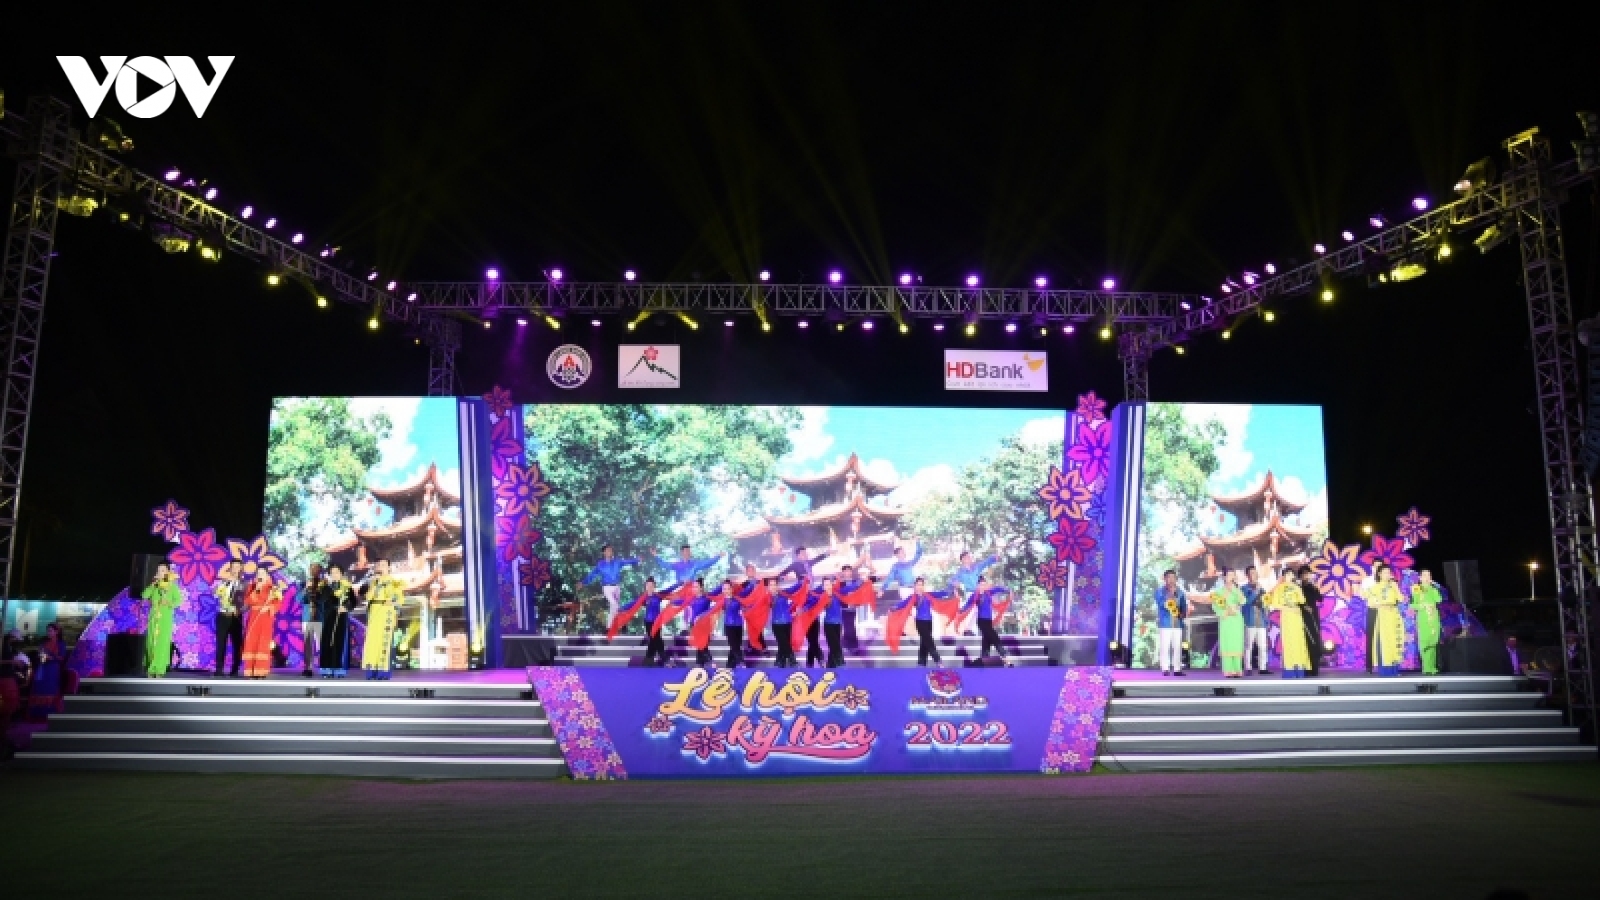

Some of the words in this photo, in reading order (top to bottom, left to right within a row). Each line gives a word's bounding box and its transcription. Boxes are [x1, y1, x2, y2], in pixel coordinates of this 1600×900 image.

[947, 361, 1024, 379] HDBank
[742, 671, 838, 715] hội
[789, 715, 877, 752] hoa
[904, 721, 1012, 745] 2022
